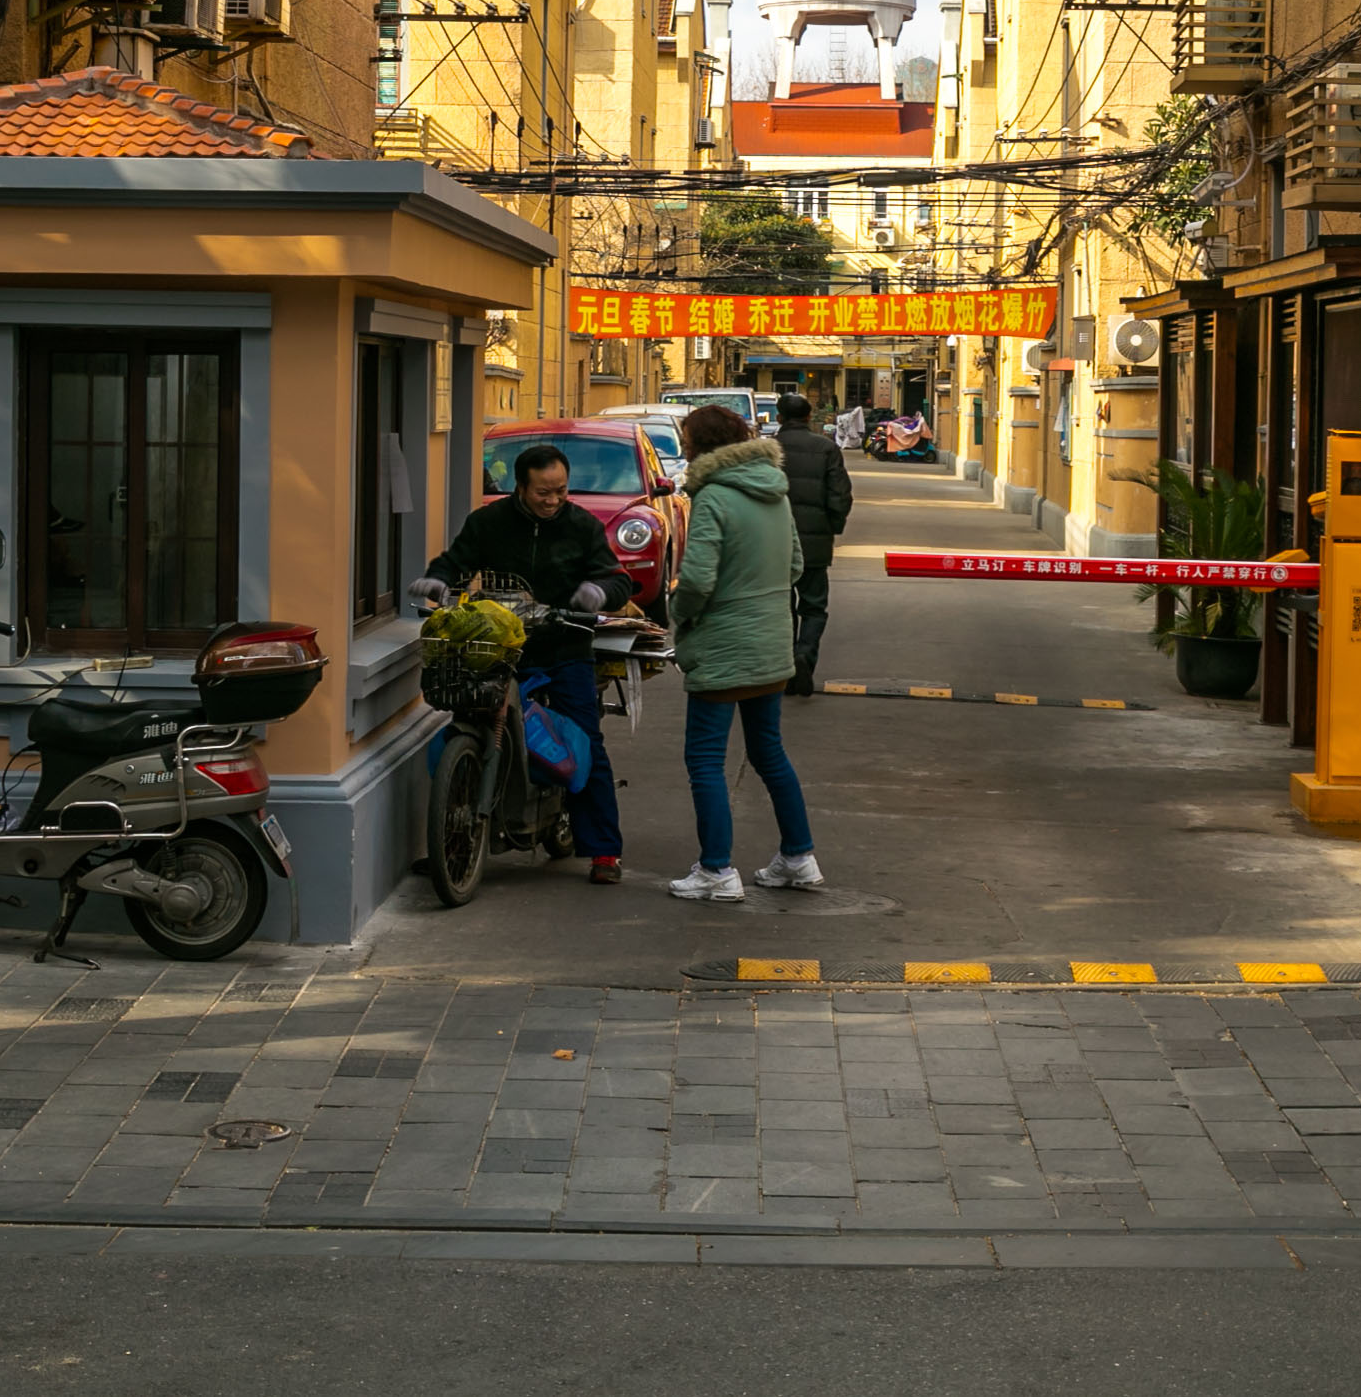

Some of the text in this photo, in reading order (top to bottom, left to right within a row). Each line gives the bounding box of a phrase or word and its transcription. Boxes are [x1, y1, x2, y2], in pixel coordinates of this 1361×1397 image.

[577, 291, 1047, 335] 元旦 春节 结婚 乔迁 开业禁止燃放烟花爆竹
[143, 721, 178, 739] 雅迪
